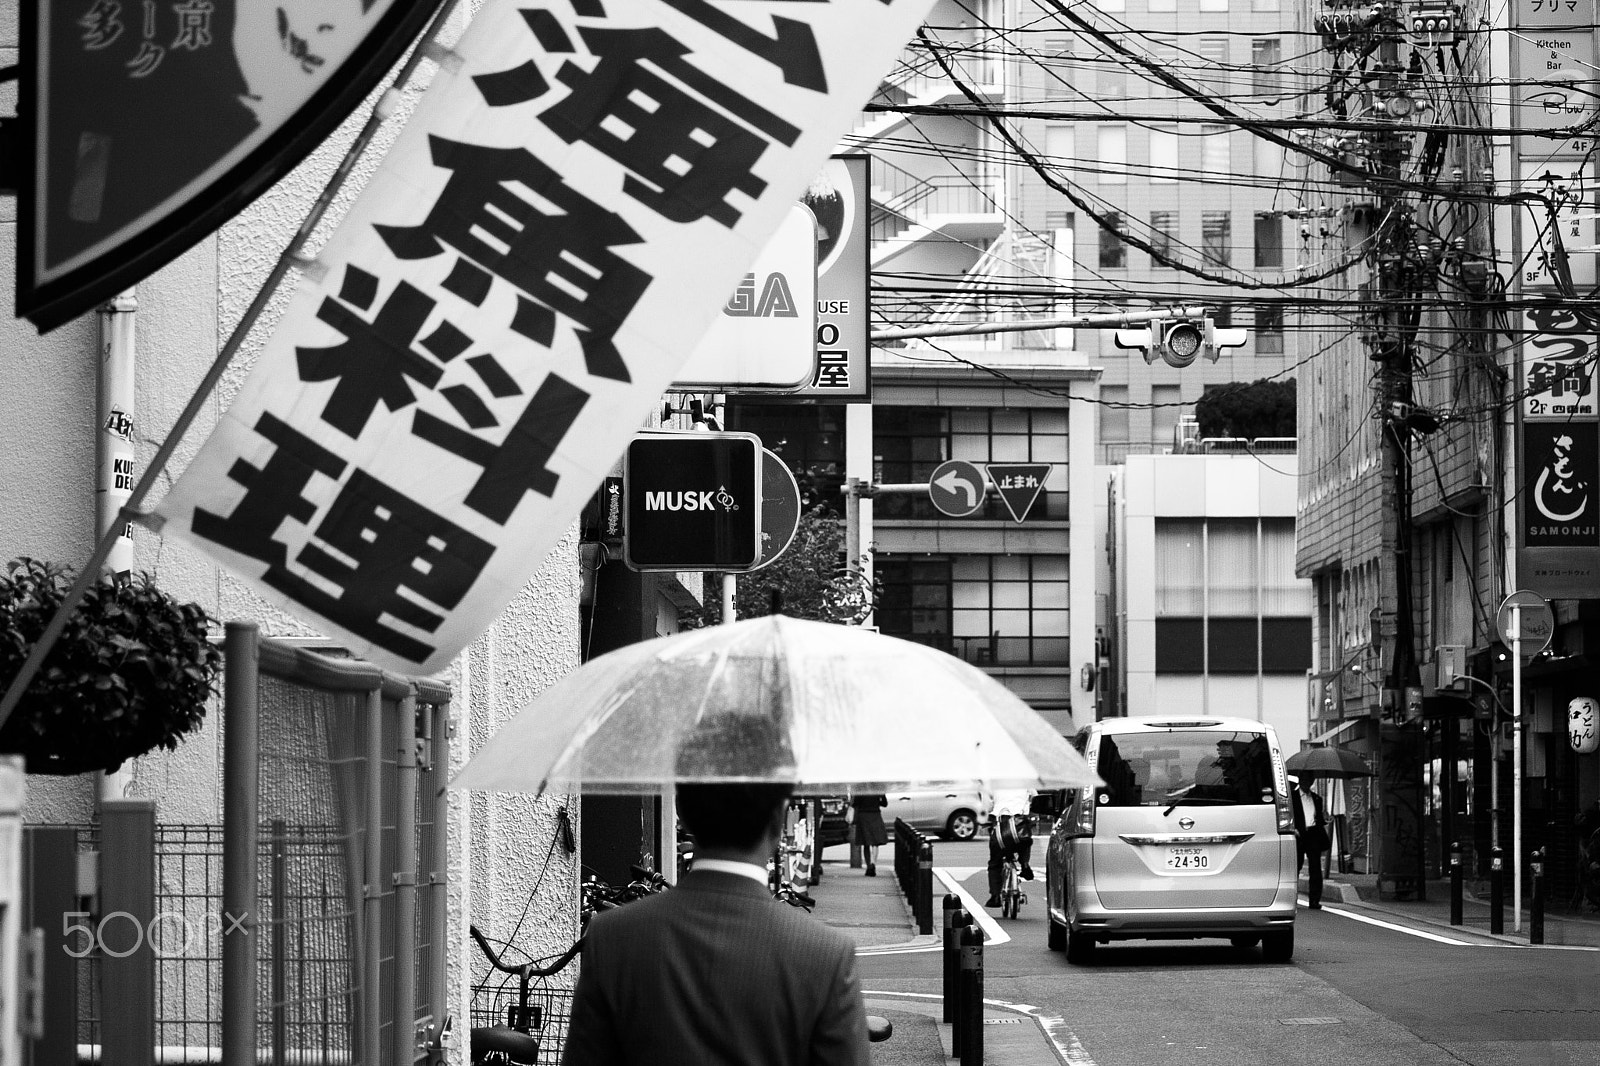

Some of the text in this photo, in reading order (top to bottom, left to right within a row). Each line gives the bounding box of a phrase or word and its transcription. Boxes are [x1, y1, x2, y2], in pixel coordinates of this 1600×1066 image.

[1536, 40, 1572, 49] Kitchen
[1550, 51, 1559, 59] &
[1546, 61, 1563, 70] Bar
[1571, 141, 1588, 152] 4F
[1526, 272, 1540, 281] 3F
[1529, 398, 1548, 414] 2F
[999, 474, 1039, 489] 止まれ
[645, 491, 716, 511] MUSK
[1530, 526, 1595, 535] SAMONJI
[1582, 702, 1595, 739] うどん
[1174, 855, 1208, 868] 24-90
